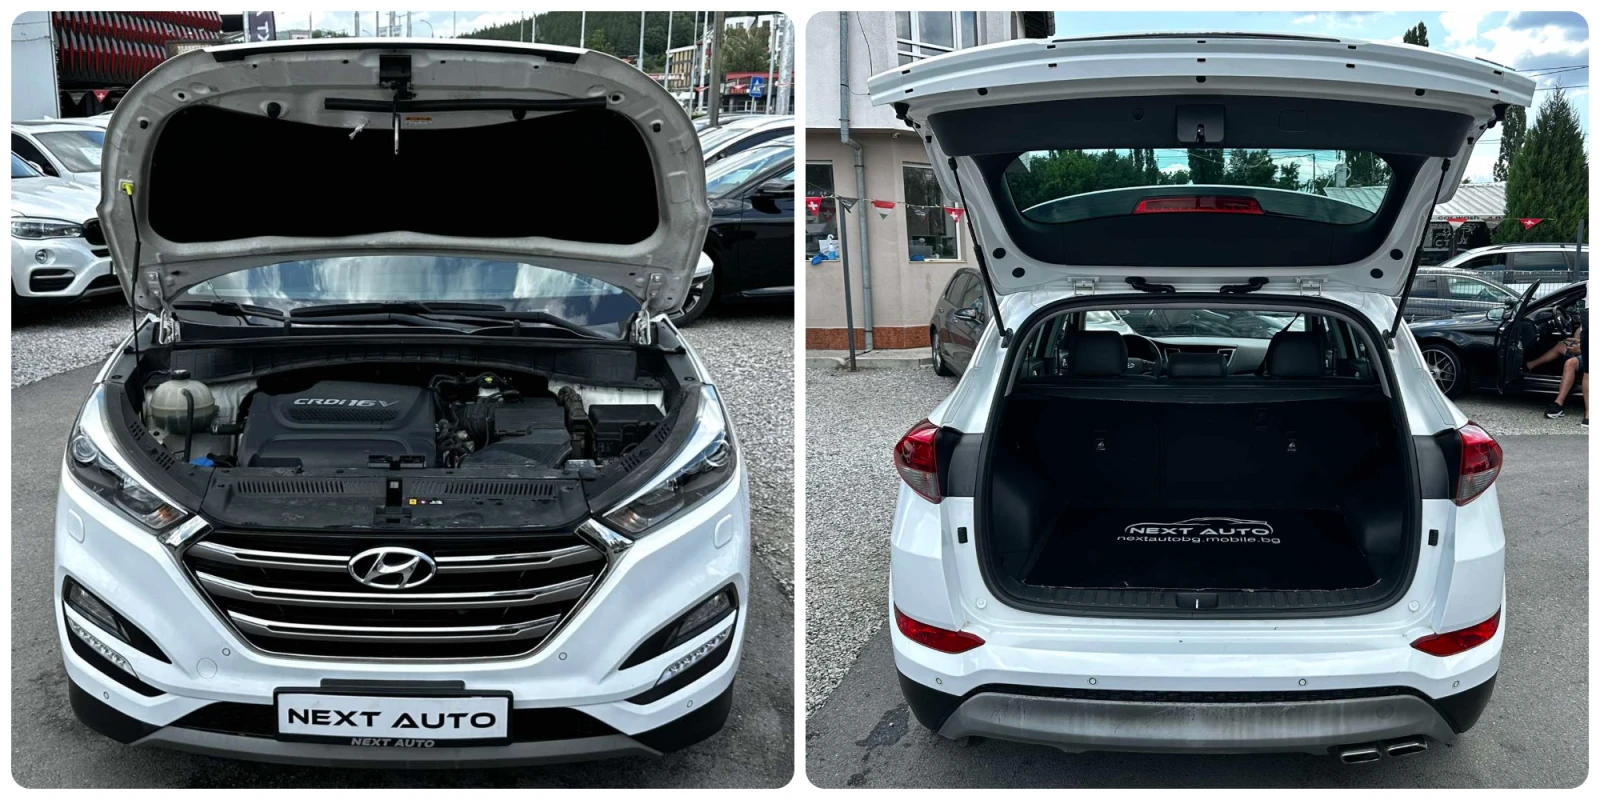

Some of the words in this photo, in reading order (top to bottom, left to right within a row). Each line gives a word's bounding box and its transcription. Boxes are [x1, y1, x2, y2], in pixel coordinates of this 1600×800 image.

[1129, 527, 1194, 535] NEXT
[1200, 528, 1270, 536] AUTO
[1117, 536, 1281, 544] nextautobg.mobile.bg
[287, 708, 382, 727] NEXT
[391, 712, 497, 729] AUTO
[351, 738, 391, 747] NEXT
[394, 739, 436, 748] AUTO
